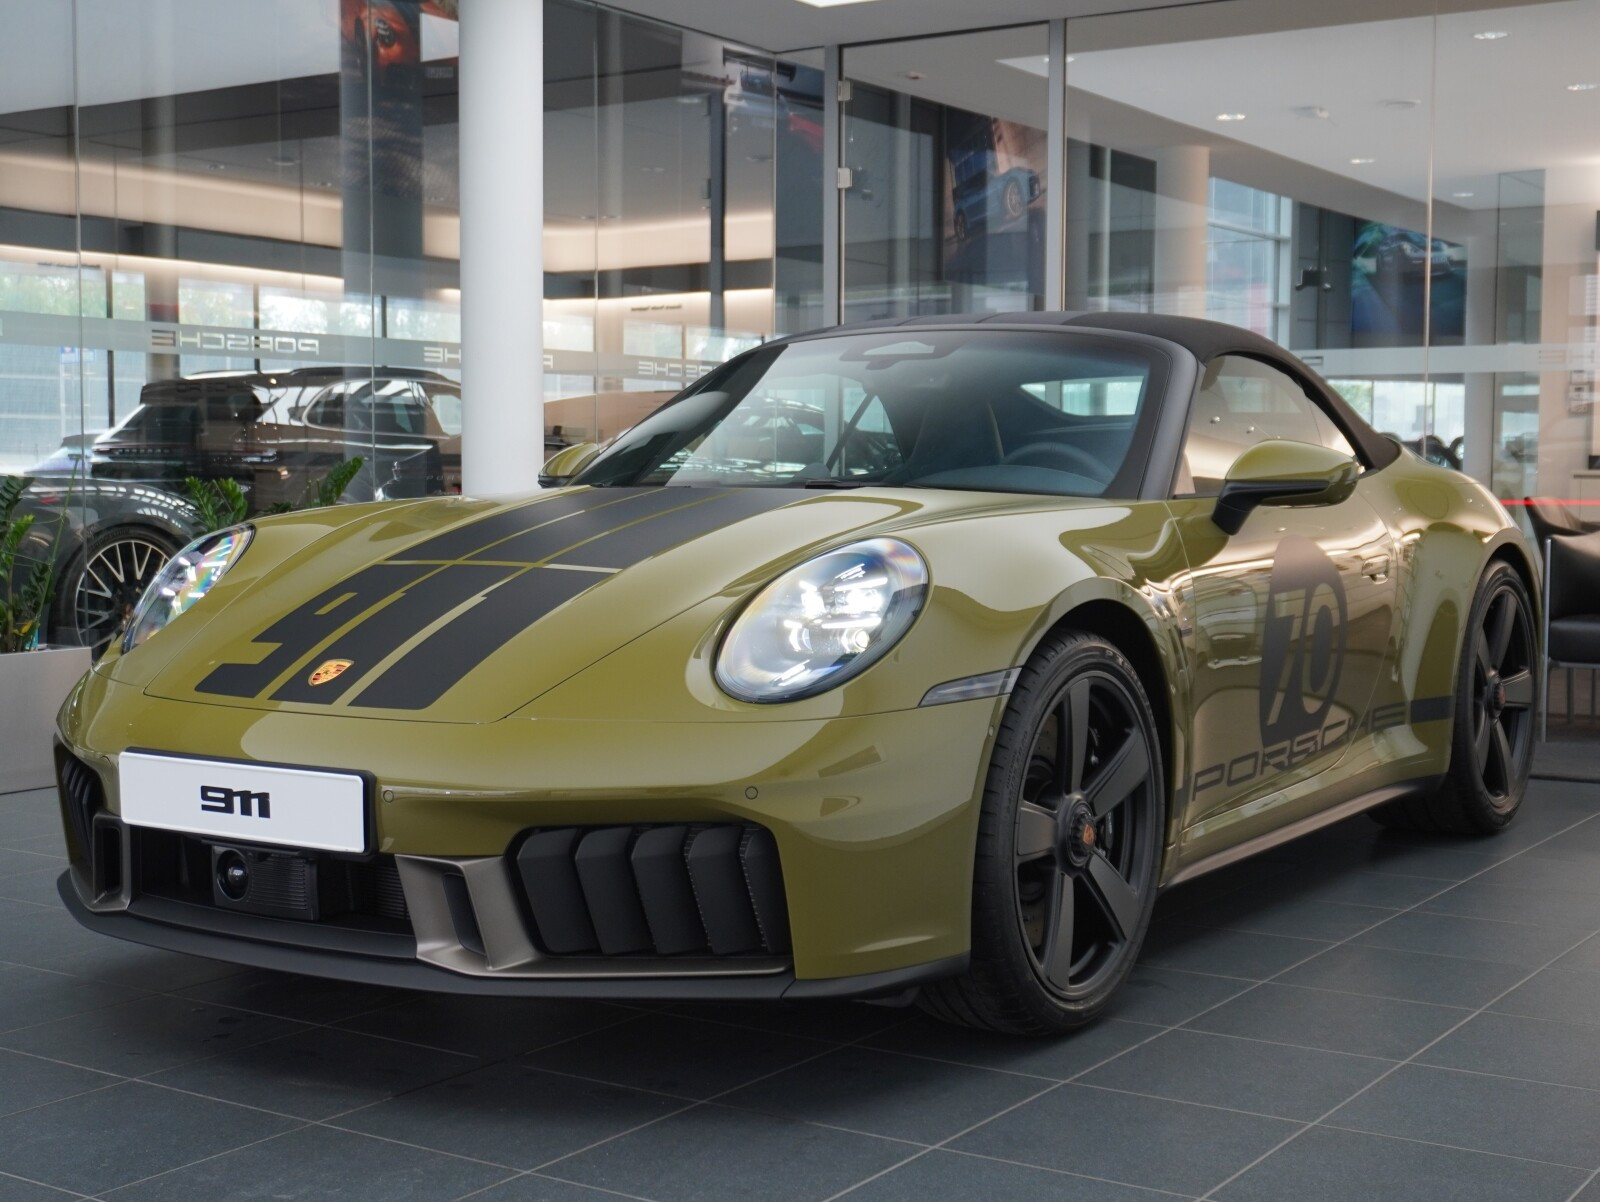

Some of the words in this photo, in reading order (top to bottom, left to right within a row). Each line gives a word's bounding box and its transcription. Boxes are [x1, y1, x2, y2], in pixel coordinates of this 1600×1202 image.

[1267, 582, 1340, 726] 70
[200, 785, 270, 818] 911
[1192, 702, 1407, 802] PORSCHE
